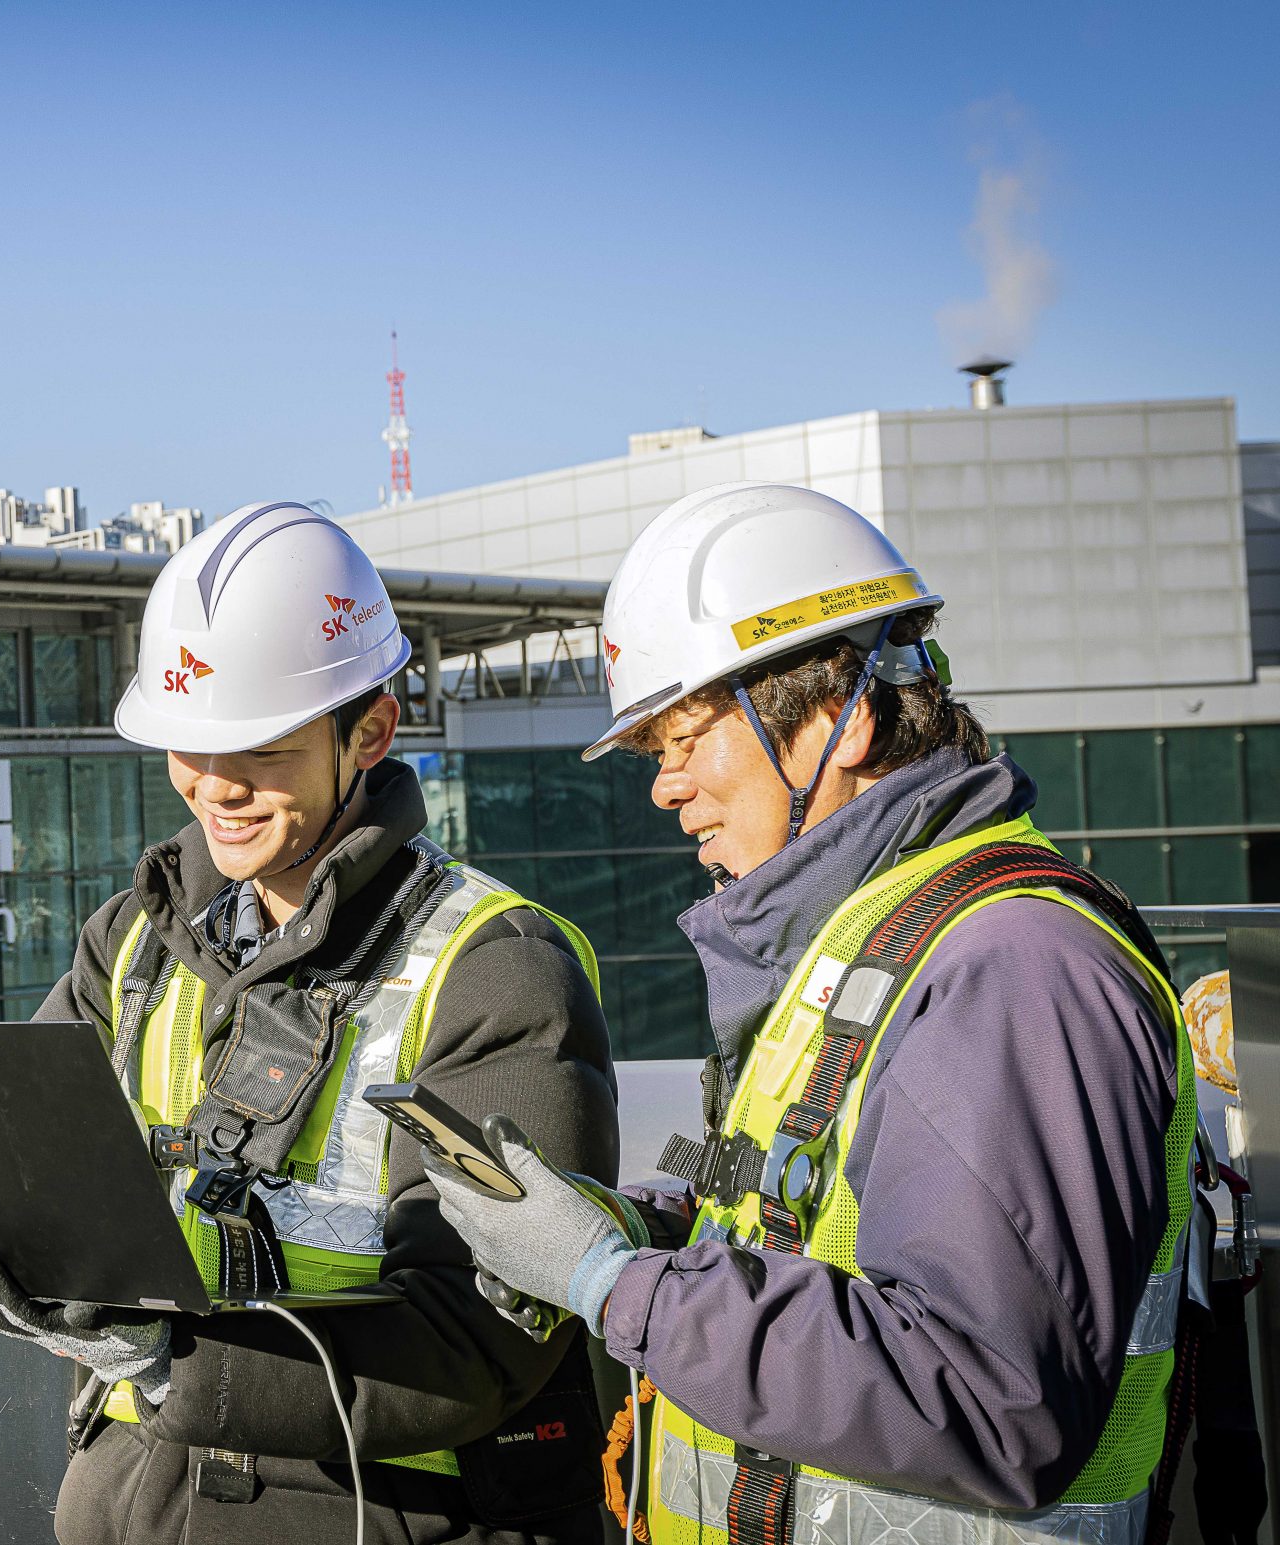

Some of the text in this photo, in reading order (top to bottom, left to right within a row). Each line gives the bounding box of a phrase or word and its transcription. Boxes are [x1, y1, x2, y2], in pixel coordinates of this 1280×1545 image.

[819, 588, 856, 604] 확인하자!
[821, 599, 858, 616] 실천하자!
[322, 599, 387, 641] SK telecom
[752, 615, 806, 639] SK 오앤에스
[164, 670, 190, 694] SK
[818, 986, 833, 1003] S
[170, 1143, 184, 1152] K2
[497, 1421, 566, 1445] Think Safety K2
